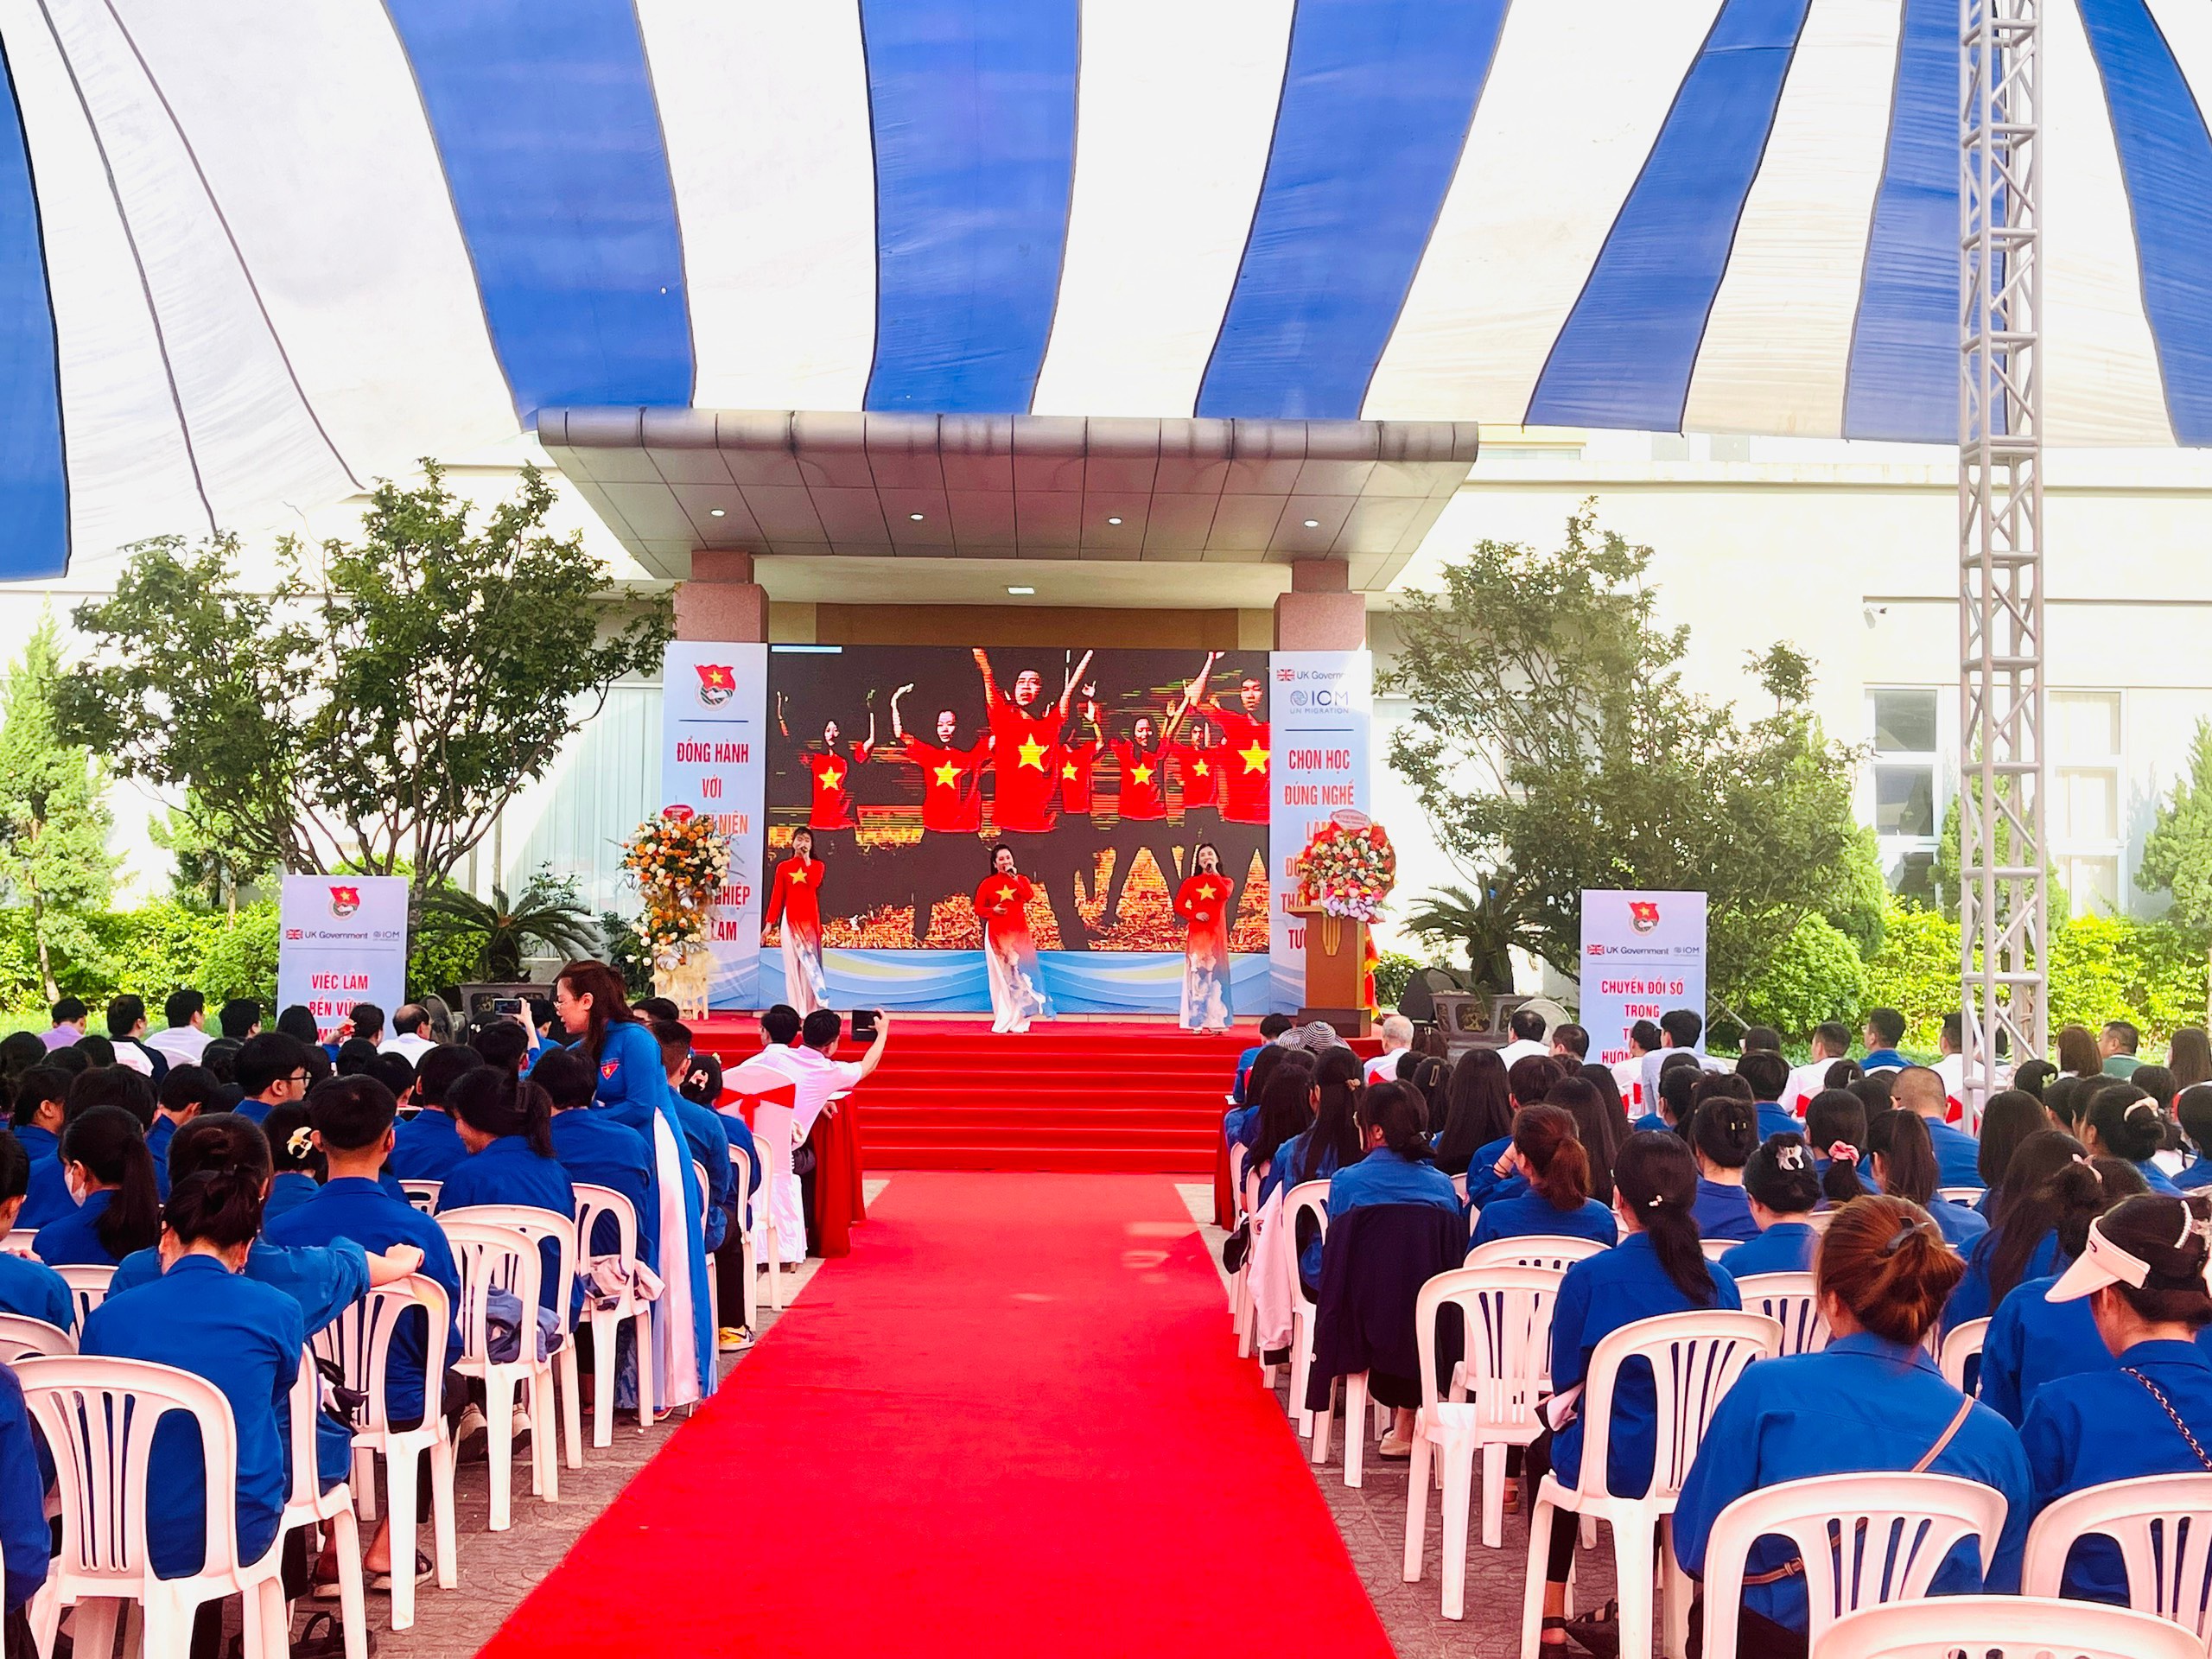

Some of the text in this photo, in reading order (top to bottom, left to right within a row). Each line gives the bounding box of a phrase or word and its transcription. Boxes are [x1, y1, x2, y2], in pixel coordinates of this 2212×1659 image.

[1297, 671, 1309, 680] UK
[1312, 690, 1348, 706] IOM
[677, 735, 749, 764] ĐỒNG HÀNH
[1289, 749, 1351, 774] CHỌN HỌC
[702, 774, 722, 798] VỚI
[1285, 781, 1318, 805] ĐÚNG
[719, 810, 749, 835] NIÊN
[715, 881, 751, 910] GHIỆP
[710, 917, 737, 942] LÀM
[1620, 946, 1669, 955] Government
[312, 971, 368, 993] VIỆC LÀM
[1669, 977, 1684, 995] SỐ
[1624, 1004, 1660, 1019] TRONG
